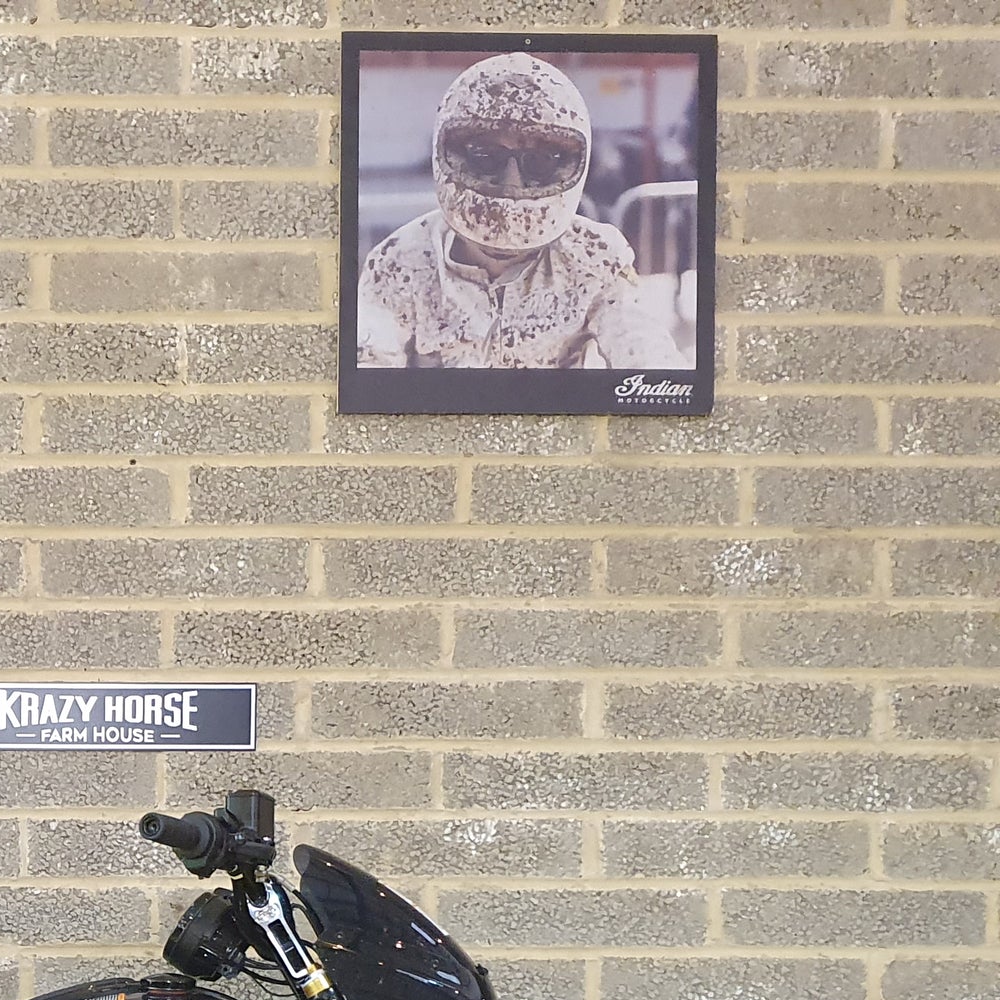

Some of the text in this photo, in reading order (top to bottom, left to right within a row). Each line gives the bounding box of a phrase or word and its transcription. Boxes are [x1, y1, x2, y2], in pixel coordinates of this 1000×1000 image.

[614, 374, 694, 396] Indian
[104, 690, 198, 732] HORSE
[40, 727, 155, 744] FARM HOUSE
